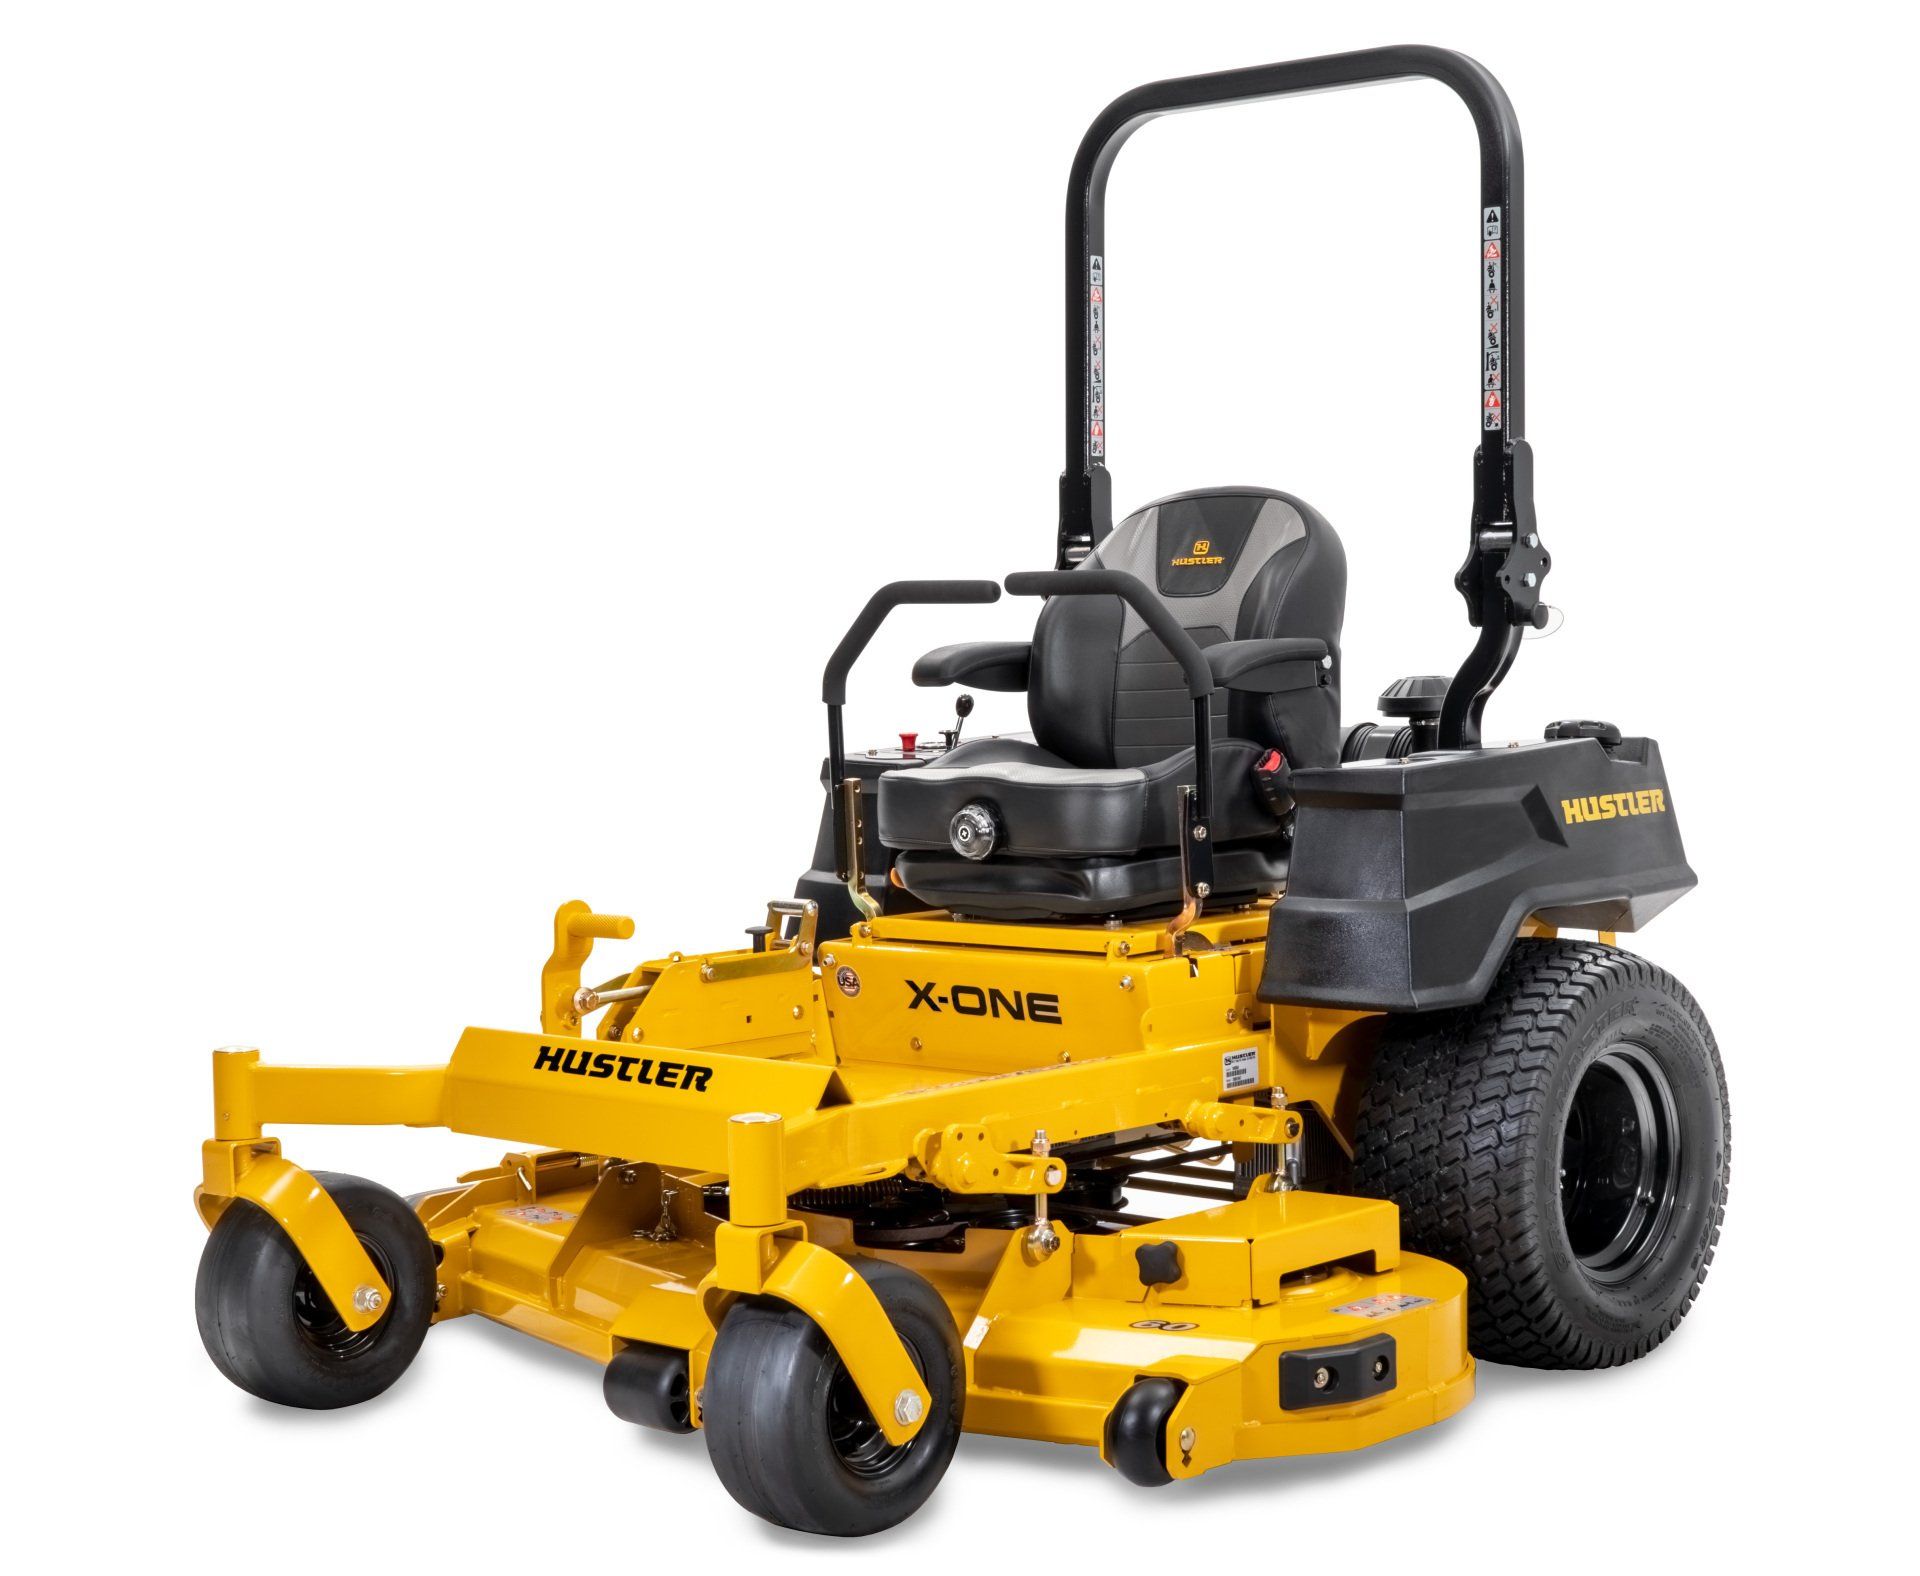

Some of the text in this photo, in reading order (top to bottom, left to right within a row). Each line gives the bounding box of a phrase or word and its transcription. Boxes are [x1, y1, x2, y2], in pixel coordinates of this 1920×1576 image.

[1171, 556, 1223, 567] HUSTLER
[1561, 789, 1665, 825] HUSTLER
[837, 975, 860, 988] USA
[904, 979, 1063, 1025] X-ONE
[533, 1045, 714, 1093] HUSTLER
[1128, 1319, 1201, 1332] 60
